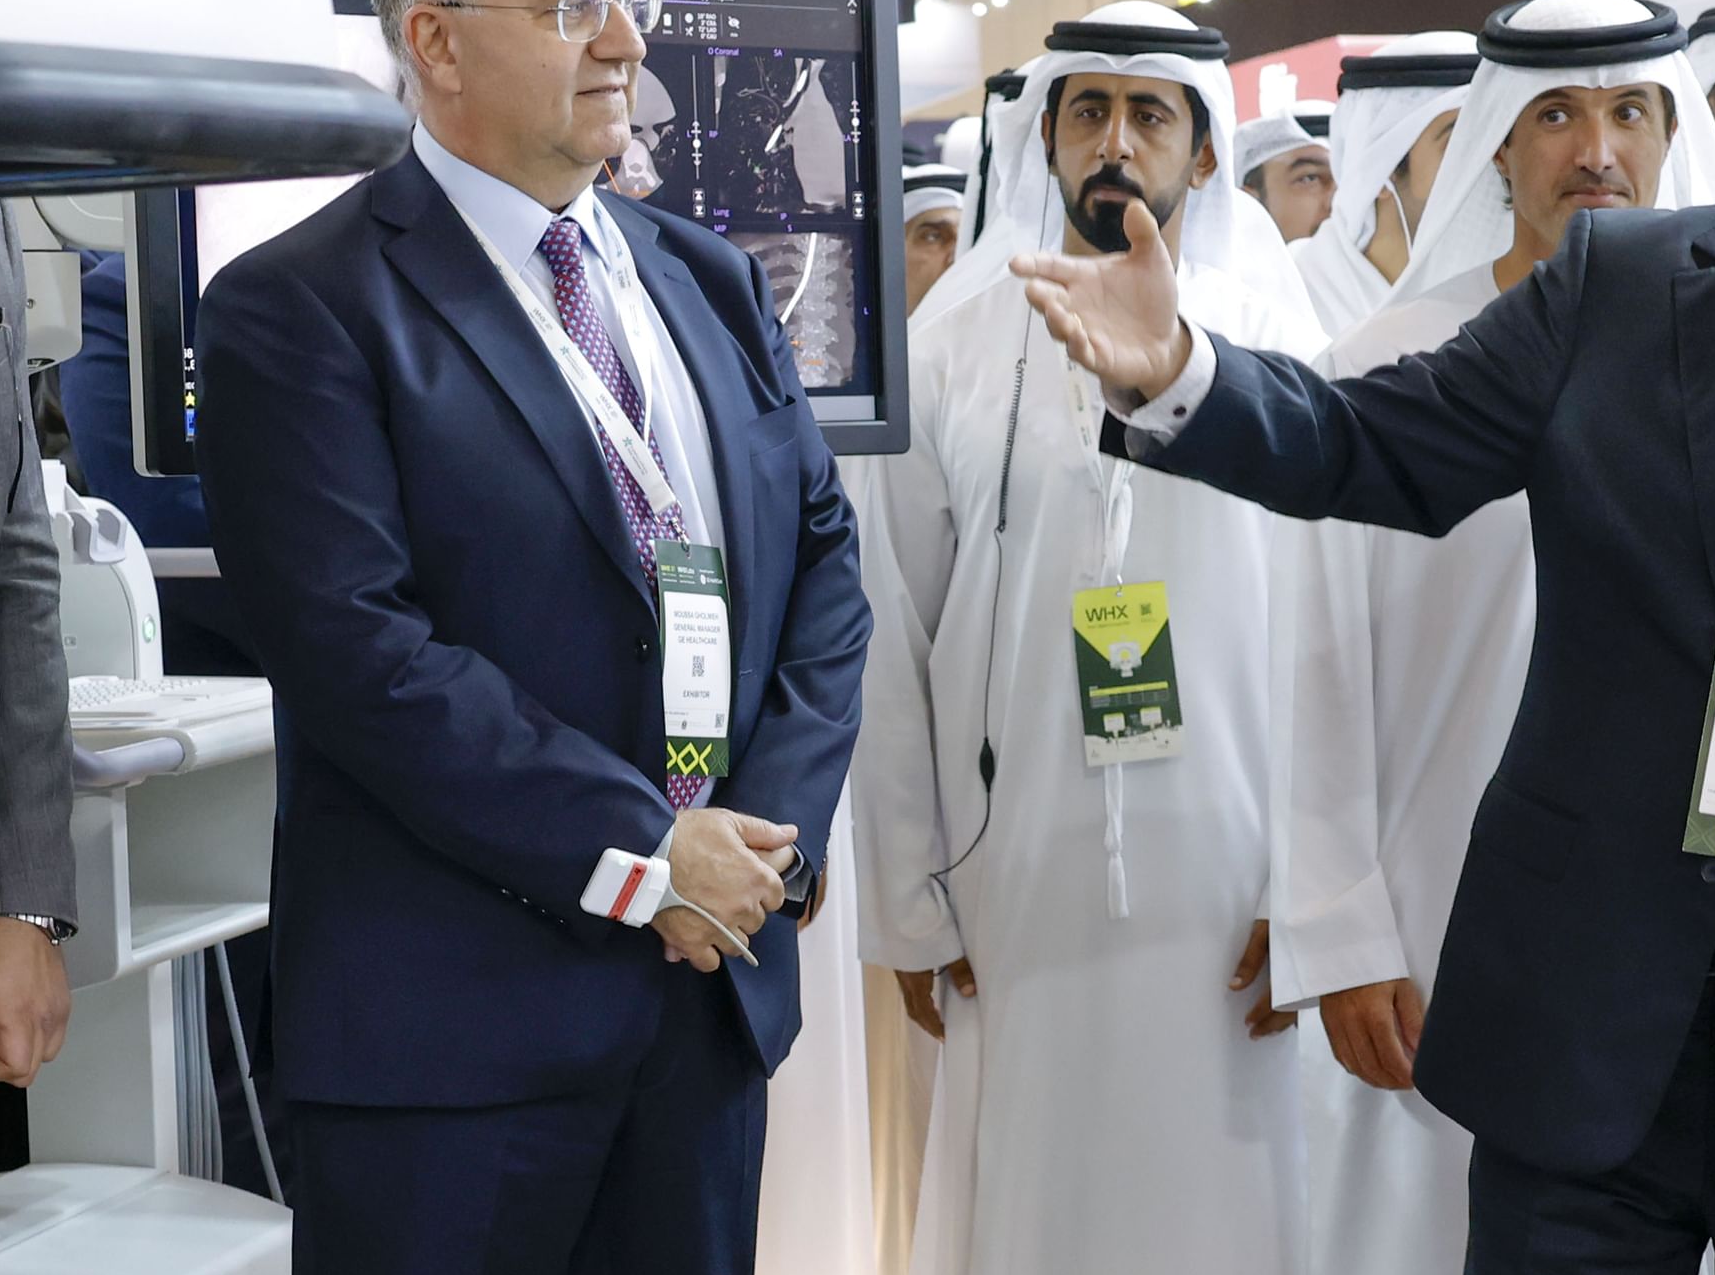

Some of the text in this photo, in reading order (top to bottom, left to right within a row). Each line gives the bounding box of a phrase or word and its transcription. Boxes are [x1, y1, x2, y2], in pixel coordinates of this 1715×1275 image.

[714, 46, 740, 57] Coronal
[713, 207, 730, 218] Lung
[1085, 604, 1128, 622] WHX
[685, 636, 718, 645] HEALTHCARE
